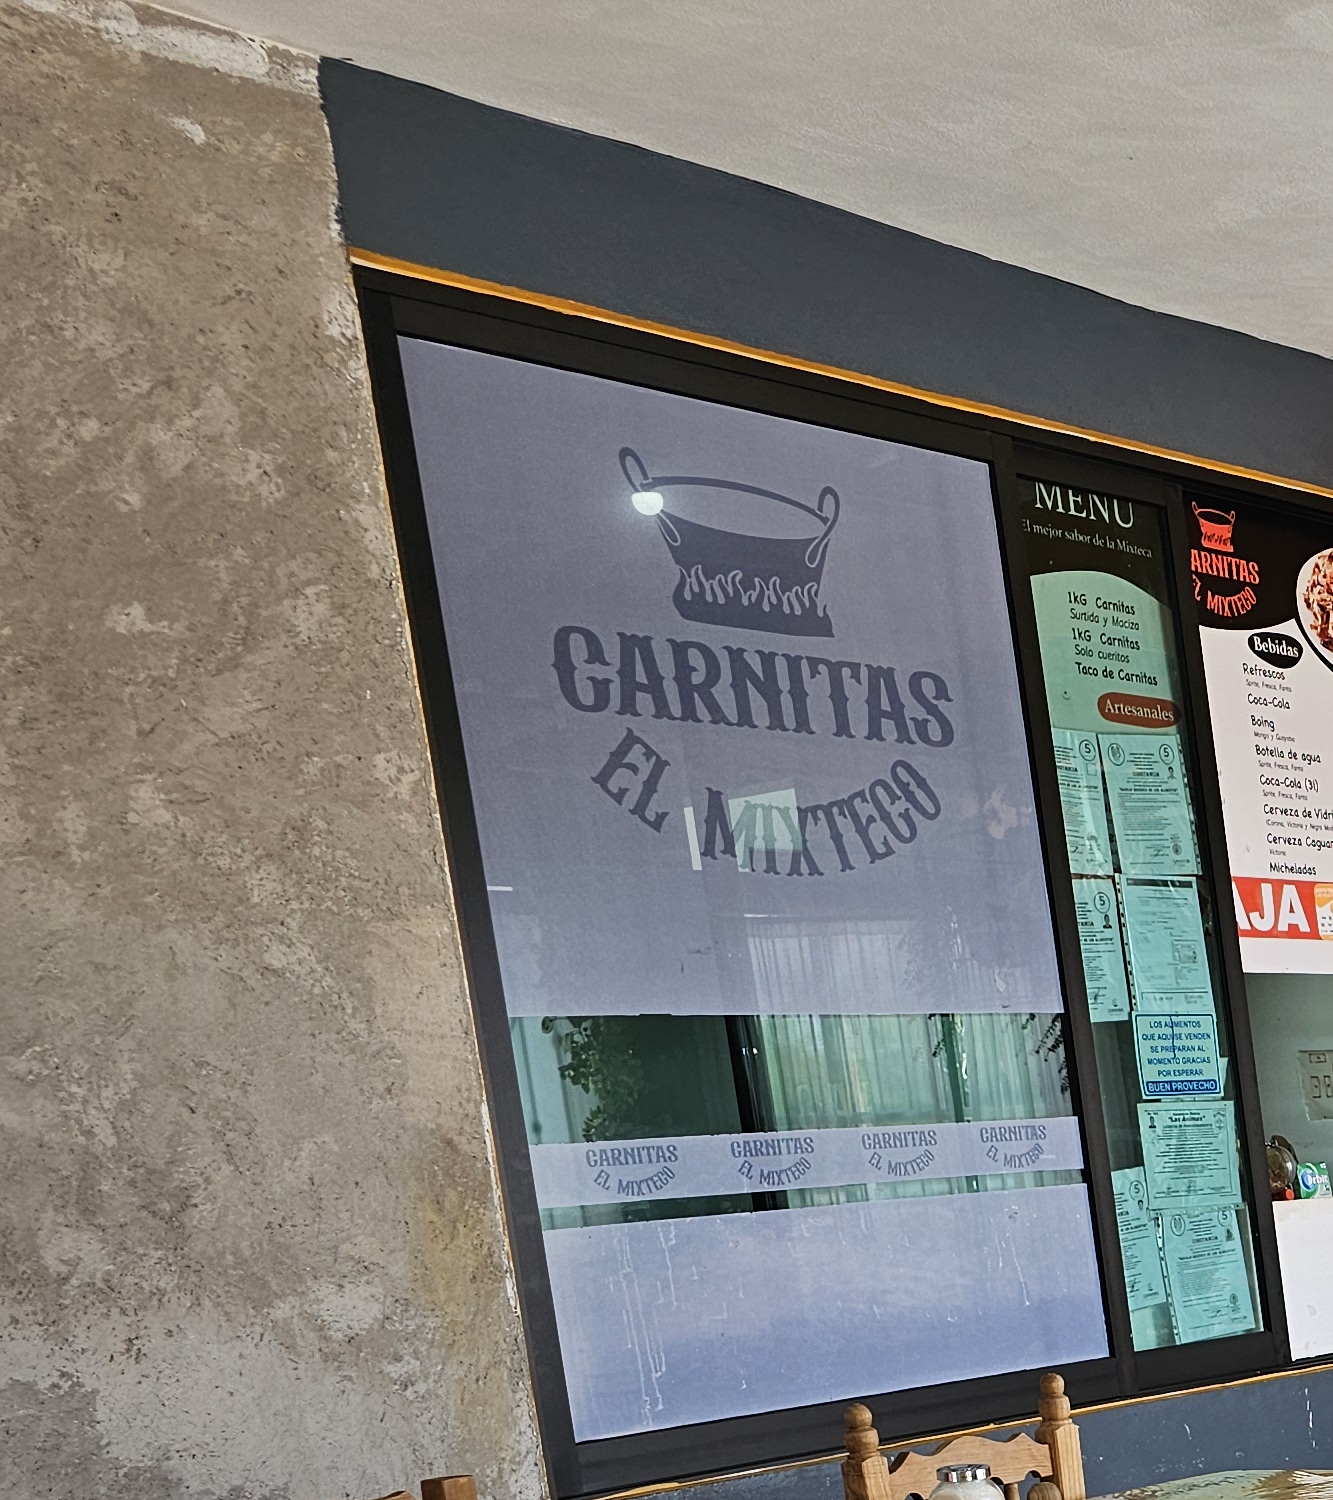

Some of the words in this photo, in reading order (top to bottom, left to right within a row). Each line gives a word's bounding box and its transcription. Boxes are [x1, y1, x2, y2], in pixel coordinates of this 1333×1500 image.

[1035, 482, 1133, 528] MENU
[1033, 524, 1062, 539] mejor
[1065, 529, 1091, 544] sabor
[1093, 534, 1105, 547] de
[1106, 537, 1115, 550] la
[1117, 539, 1152, 558] Mixteca
[1095, 597, 1136, 615] Carnitas
[1207, 586, 1256, 617] MIXTECO
[1070, 608, 1100, 623] Surtida
[1103, 616, 1108, 627] y
[1100, 633, 1140, 651] Carnitas
[1253, 635, 1299, 658] Bebidas
[1074, 644, 1094, 658] Solo
[1097, 651, 1130, 664] cueritos
[1075, 662, 1098, 677] Taco
[1102, 666, 1114, 679] de
[1118, 669, 1158, 686] Carnitas
[1242, 663, 1286, 680] Refrescos
[551, 625, 955, 748] CARNITAS
[1247, 693, 1290, 709] Coca-Cola
[1105, 699, 1174, 722] Artesanales
[1251, 715, 1275, 732] Boing
[1084, 743, 1091, 754] 5
[1163, 747, 1170, 758] 5
[1255, 744, 1284, 758] Botella
[1288, 748, 1298, 760] de
[1302, 753, 1321, 765] agua
[1259, 774, 1302, 789] Coca-Cola
[590, 727, 671, 833] EL
[700, 759, 942, 877] MIXTECO
[1263, 804, 1299, 817] Cerveza
[1302, 807, 1312, 819] de
[1266, 833, 1302, 846] Cerveza
[1270, 861, 1317, 876] Micheladas
[1098, 895, 1105, 906] 5
[1149, 1021, 1163, 1029] LOS
[1142, 1033, 1155, 1041] QUE
[1176, 1033, 1183, 1041] SE
[1150, 1045, 1159, 1053] SE
[1160, 1045, 1195, 1053] PREPARAN
[1147, 1057, 1180, 1065] MOMENTO
[1158, 1069, 1171, 1077] POR
[1148, 1082, 1171, 1092] BUEN
[1172, 1081, 1216, 1091] PROVECHO
[861, 1130, 938, 1150] CARNITAS
[980, 1124, 1047, 1143] CARNITAS
[586, 1144, 679, 1167] CARNITAS
[730, 1136, 815, 1159] CARNITAS
[986, 1144, 998, 1163] EL
[1003, 1142, 1044, 1169] MIXTECO
[738, 1160, 754, 1180] EL
[759, 1157, 812, 1186] MIXTECO
[868, 1151, 882, 1171] EL
[887, 1149, 935, 1176] MIXTECO
[593, 1169, 610, 1190] EL
[617, 1166, 675, 1196] MIXTECO
[1134, 1184, 1140, 1194] 5
[1222, 1210, 1228, 1220] 5
